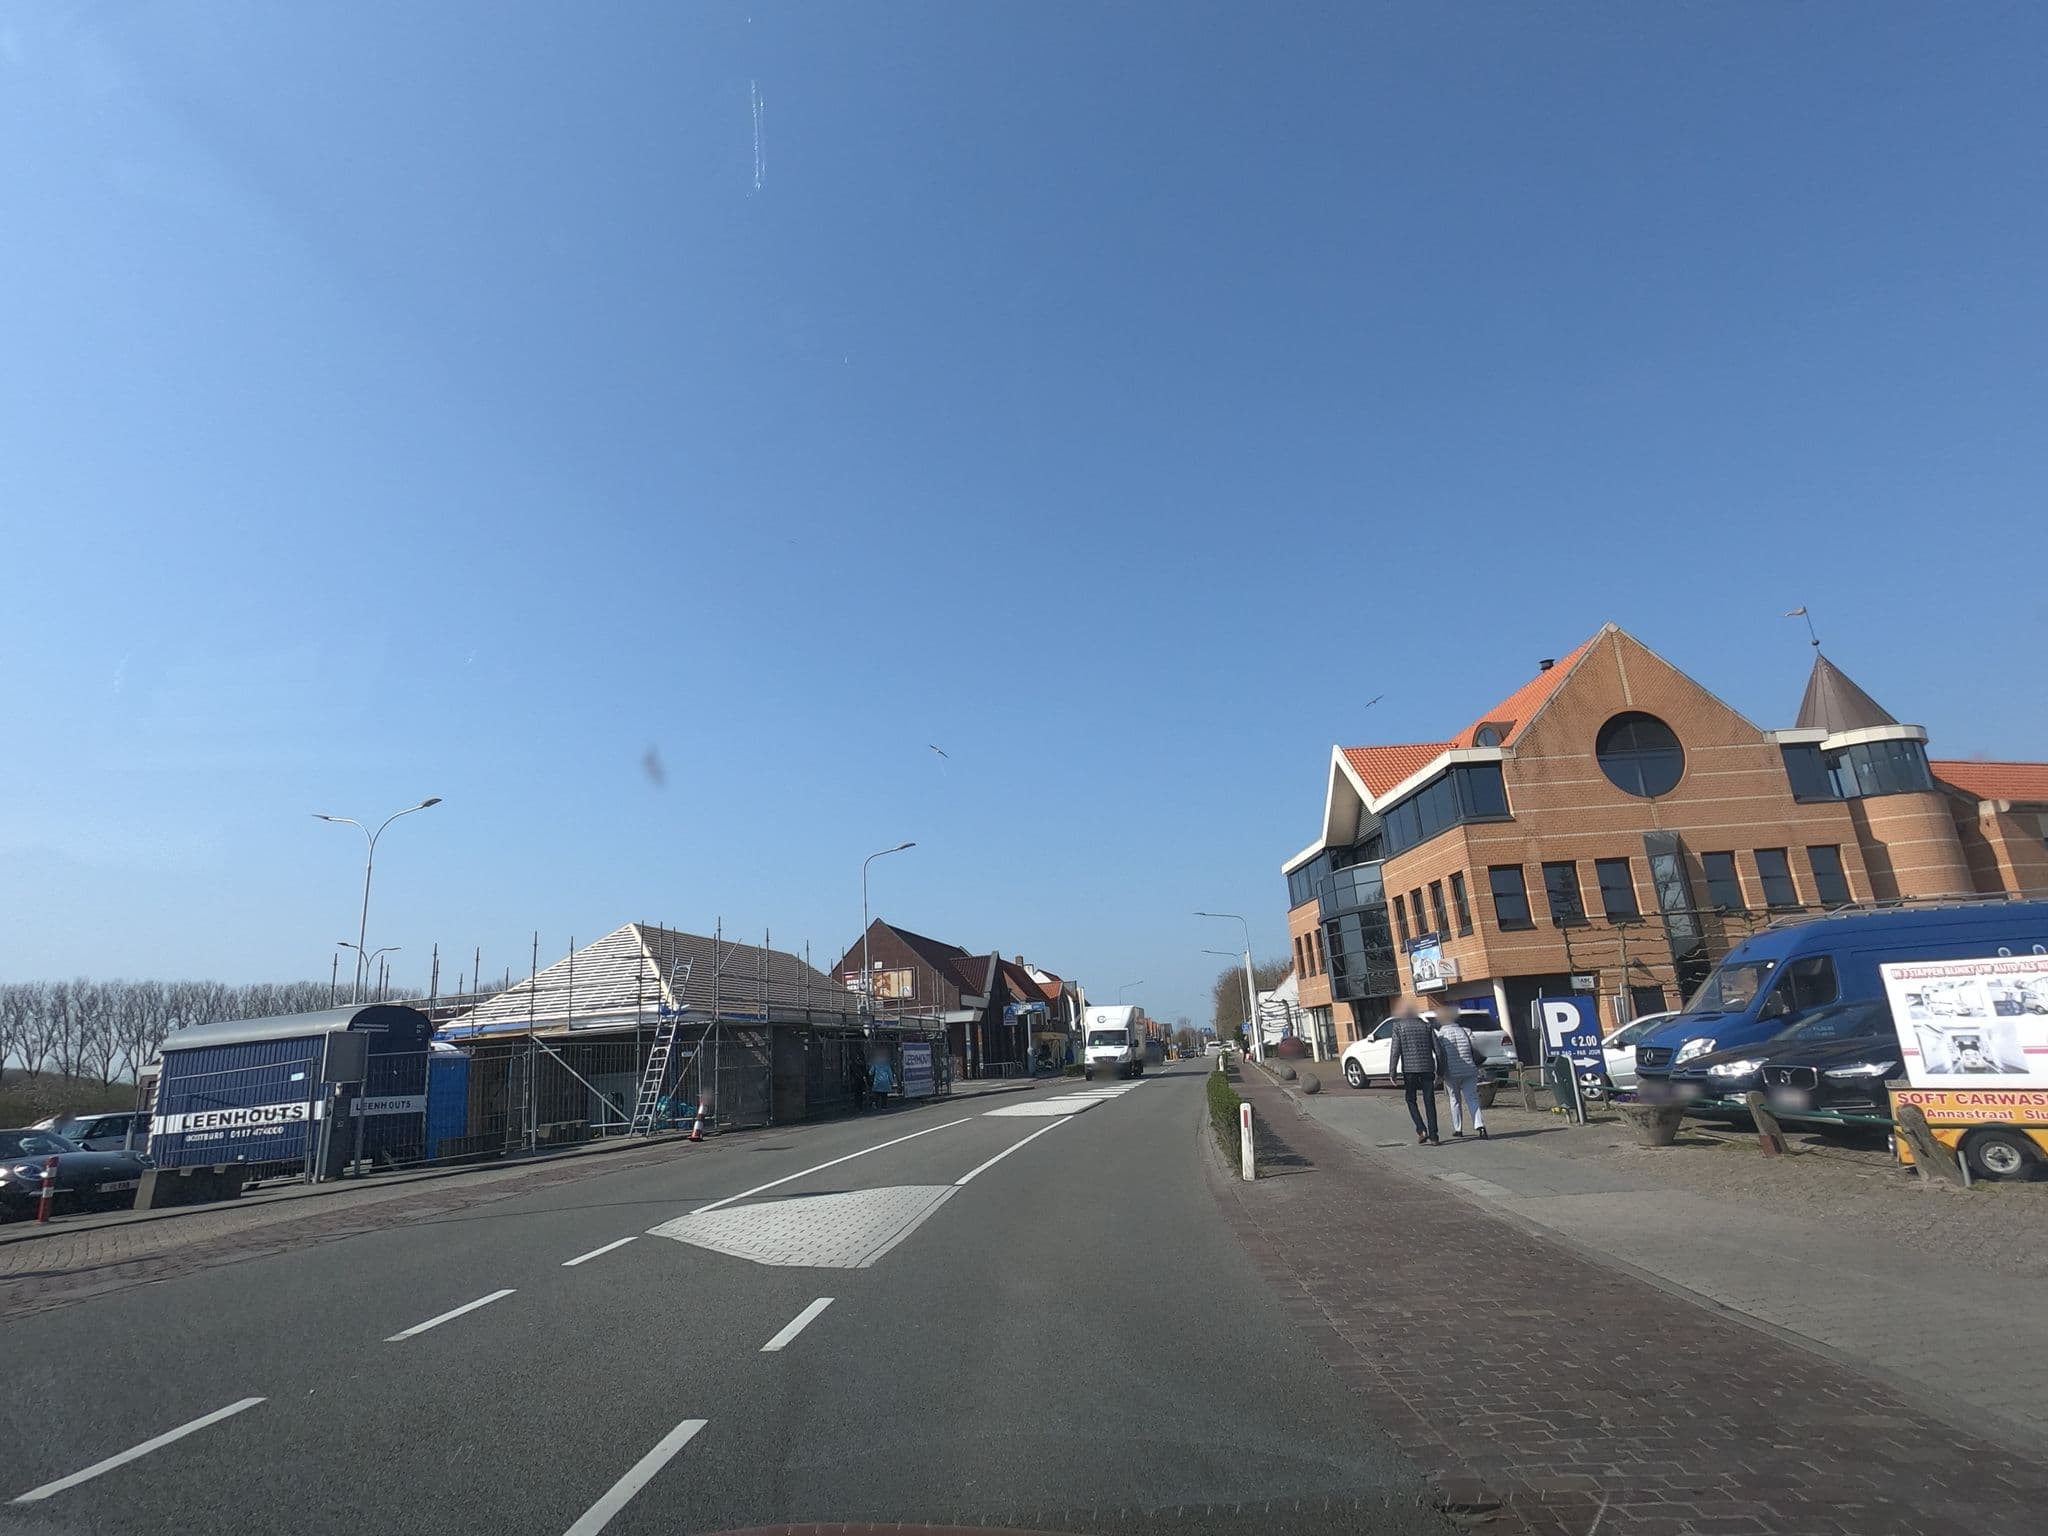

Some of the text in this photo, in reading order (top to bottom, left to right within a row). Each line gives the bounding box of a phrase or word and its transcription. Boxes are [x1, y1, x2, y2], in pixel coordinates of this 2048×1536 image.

[1994, 962, 2019, 975] AUTO
[1543, 1002, 1580, 1047] P
[1578, 1035, 1597, 1047] 2.00
[1897, 1092, 2048, 1106] SOFT CARWAS
[182, 1105, 304, 1128] LEENHOUTS
[1926, 1109, 2014, 1120] Annastraat
